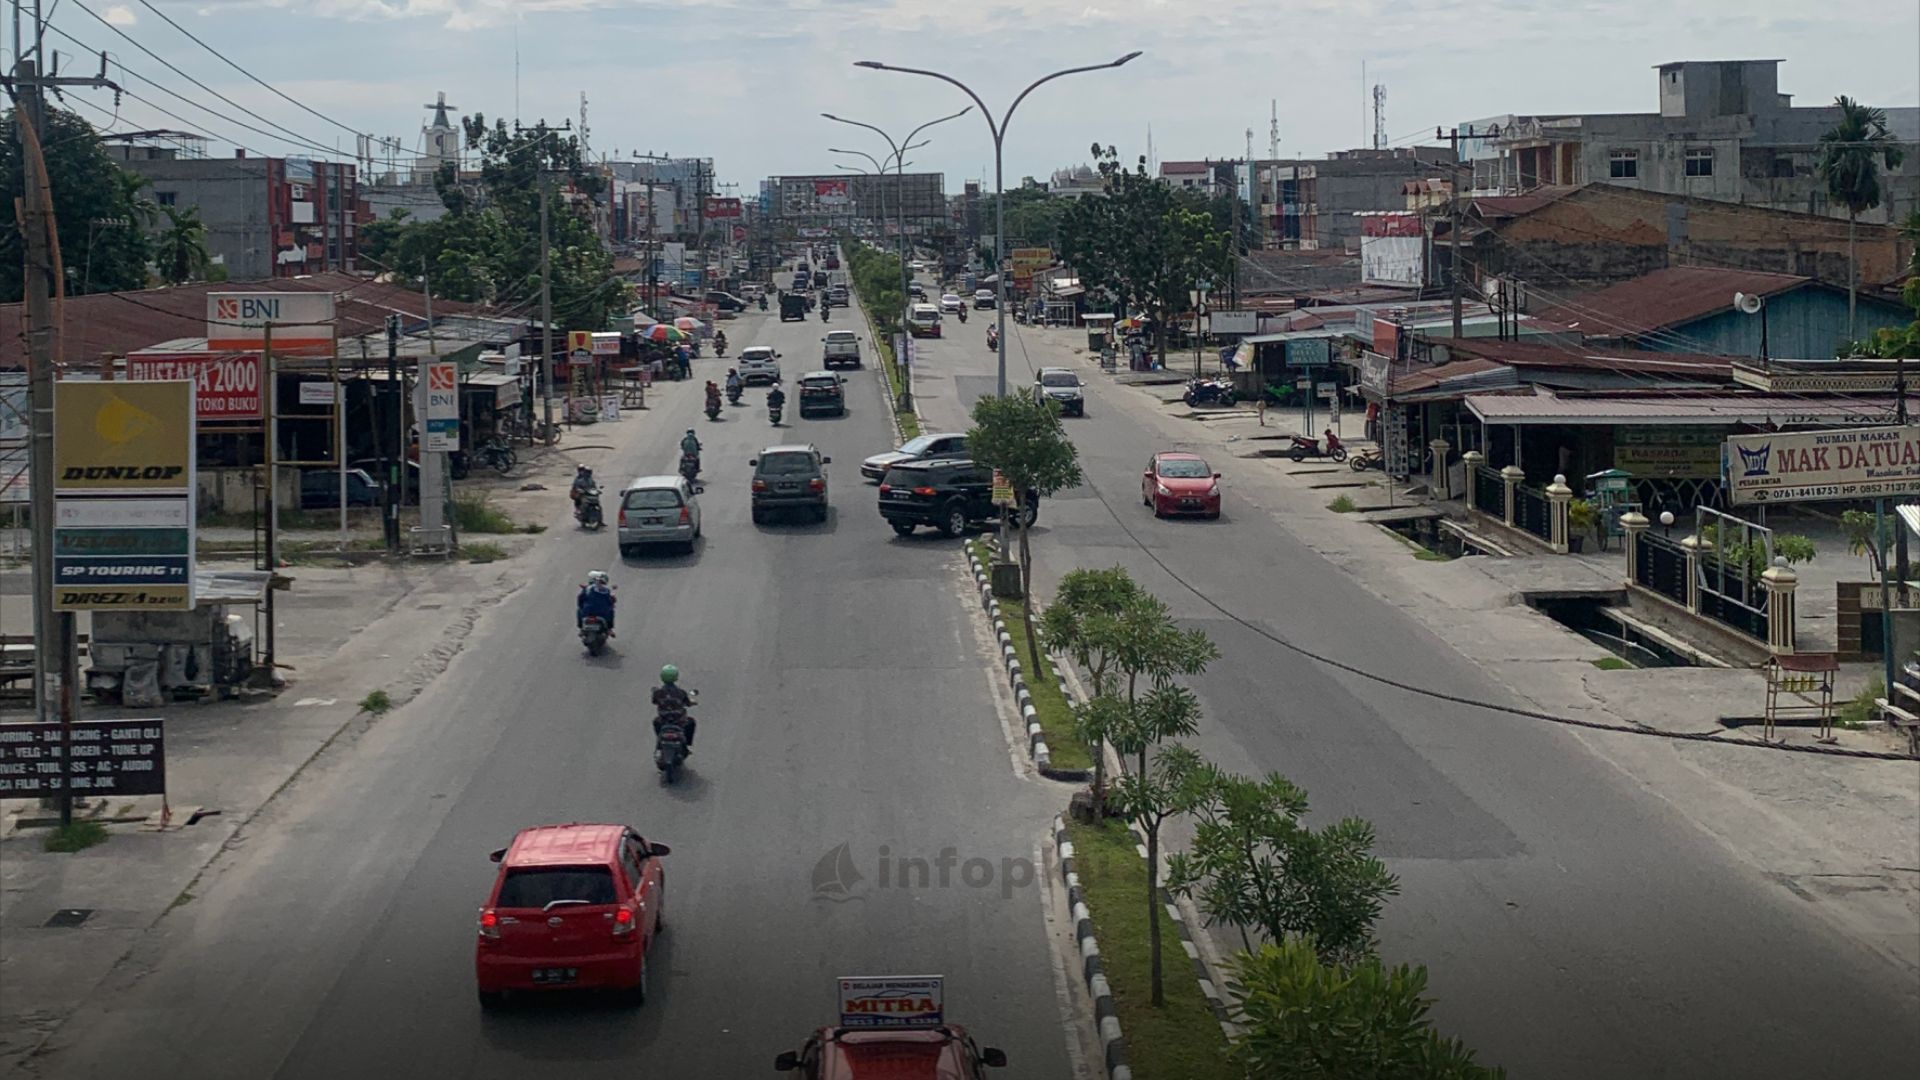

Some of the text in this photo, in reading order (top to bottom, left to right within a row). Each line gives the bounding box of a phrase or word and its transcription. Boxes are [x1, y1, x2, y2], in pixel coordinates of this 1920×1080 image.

[242, 298, 280, 319] BNI
[213, 361, 257, 392] 2000
[197, 397, 257, 412] TOKO BUKU
[431, 394, 454, 406] BNI
[1816, 431, 1900, 445] RUMAH MAKAN
[1777, 447, 1831, 474] MAK
[62, 466, 182, 479] DUNLOP
[1773, 486, 1839, 499] 0761-8418753
[1860, 485, 1882, 494] 0852
[1885, 482, 1907, 492] 7137
[61, 566, 86, 576] SP
[88, 565, 167, 576] TOURING
[61, 593, 146, 604] DIREZA
[110, 728, 142, 741] GANTI
[144, 727, 161, 740] OLI
[15, 746, 41, 758] VELG
[110, 744, 138, 756] TUNE
[140, 743, 155, 755] UP
[36, 761, 87, 774] TUBLSS
[96, 760, 112, 772] AC
[121, 759, 154, 771] AUDIO
[14, 778, 40, 790] FILM
[49, 776, 92, 789] SAUNG
[93, 776, 116, 788] JOK
[846, 999, 936, 1012] MITRA
